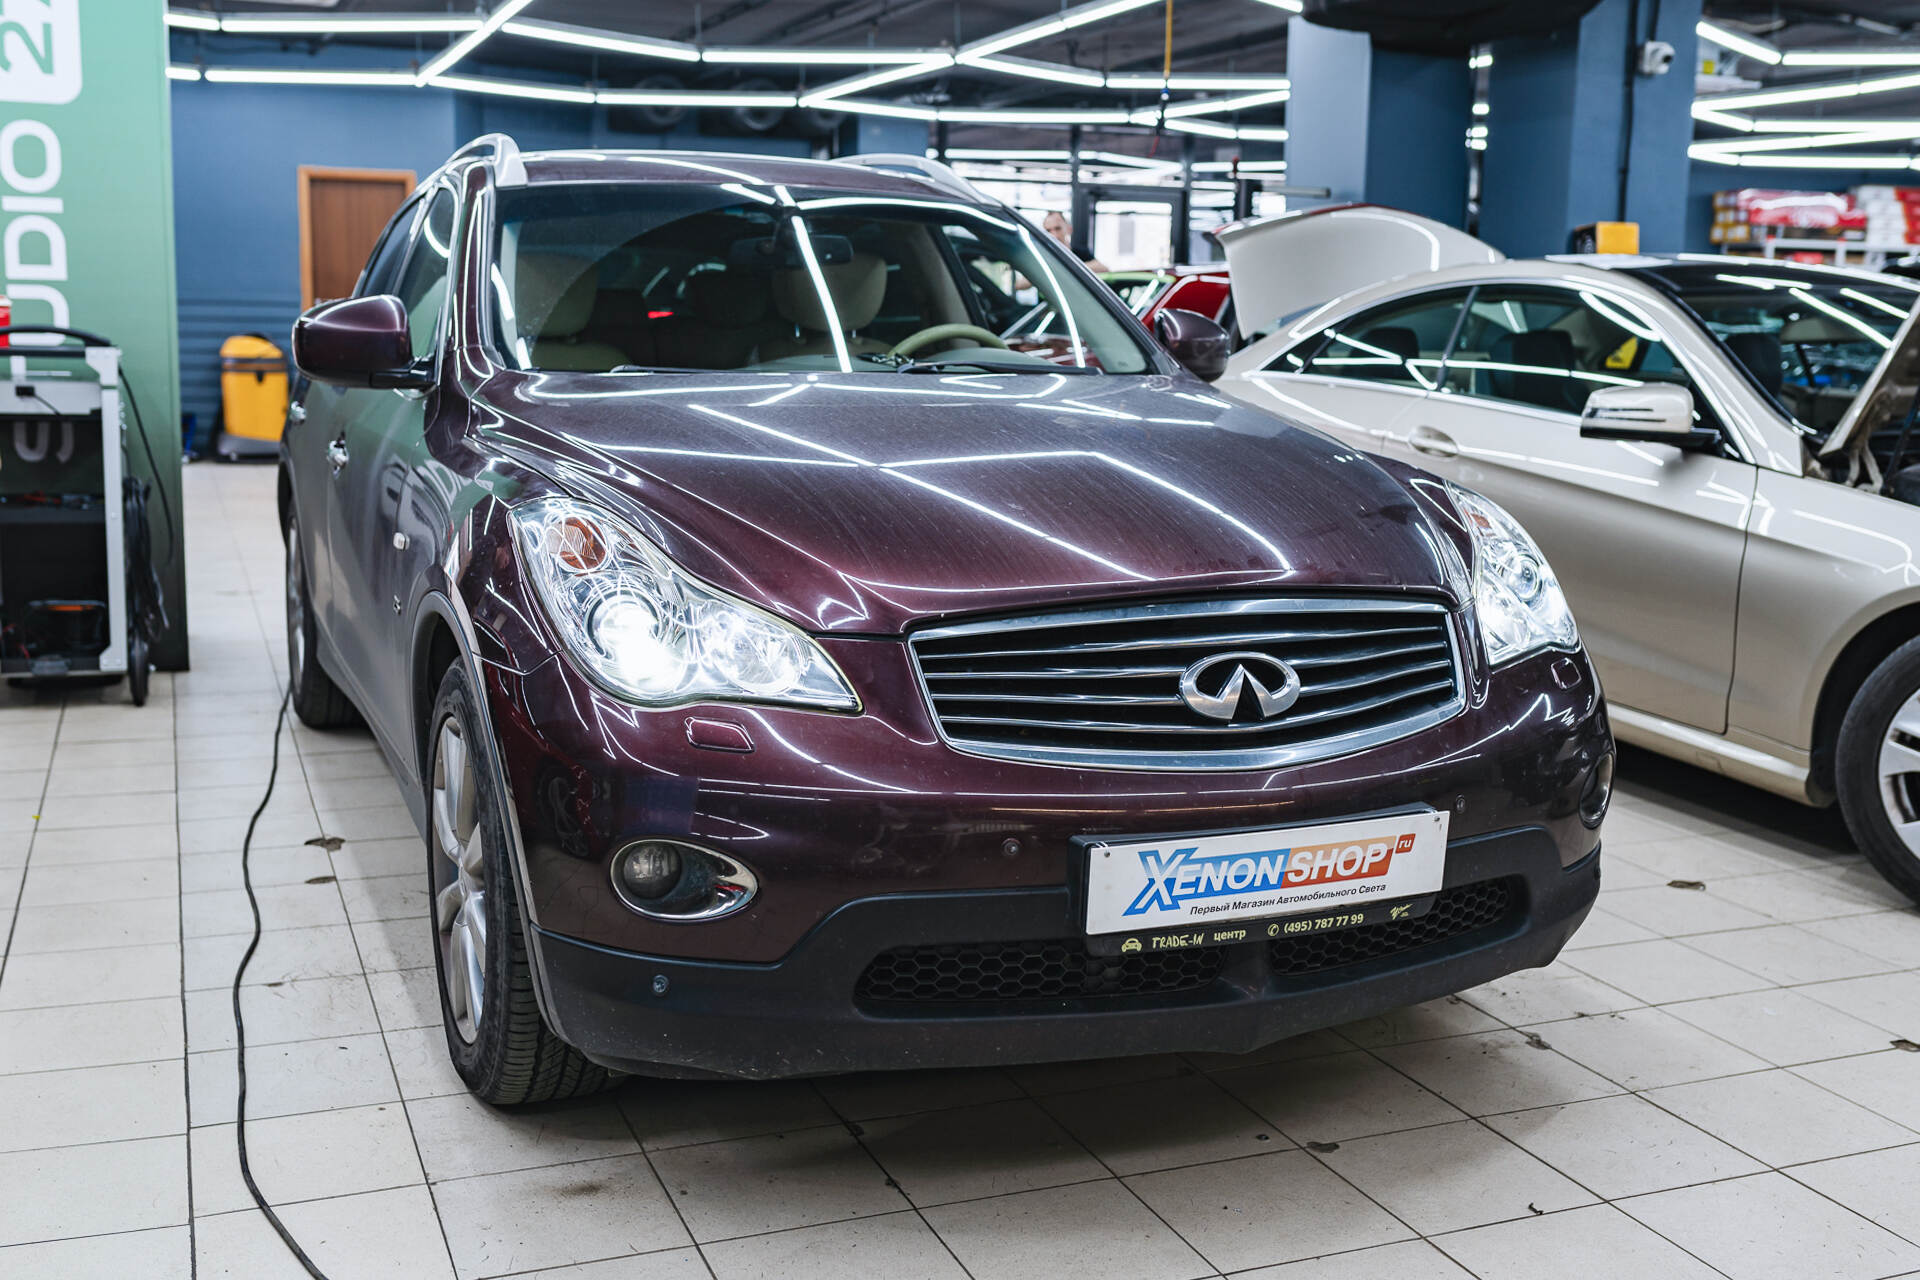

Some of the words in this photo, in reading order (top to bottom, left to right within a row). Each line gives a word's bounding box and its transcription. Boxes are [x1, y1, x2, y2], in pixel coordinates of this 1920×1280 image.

[0, 0, 54, 75] 2
[1189, 902, 1230, 915] Первый
[1231, 897, 1275, 910] Магазин
[1276, 889, 1357, 905] Автомобильного
[1358, 883, 1387, 894] Света
[1152, 932, 1205, 949] TRADE-IN
[1213, 929, 1246, 942] центр
[1283, 920, 1312, 933] (495)
[1314, 917, 1334, 929] 787
[1336, 915, 1349, 927] 77
[1350, 913, 1364, 925] 99
